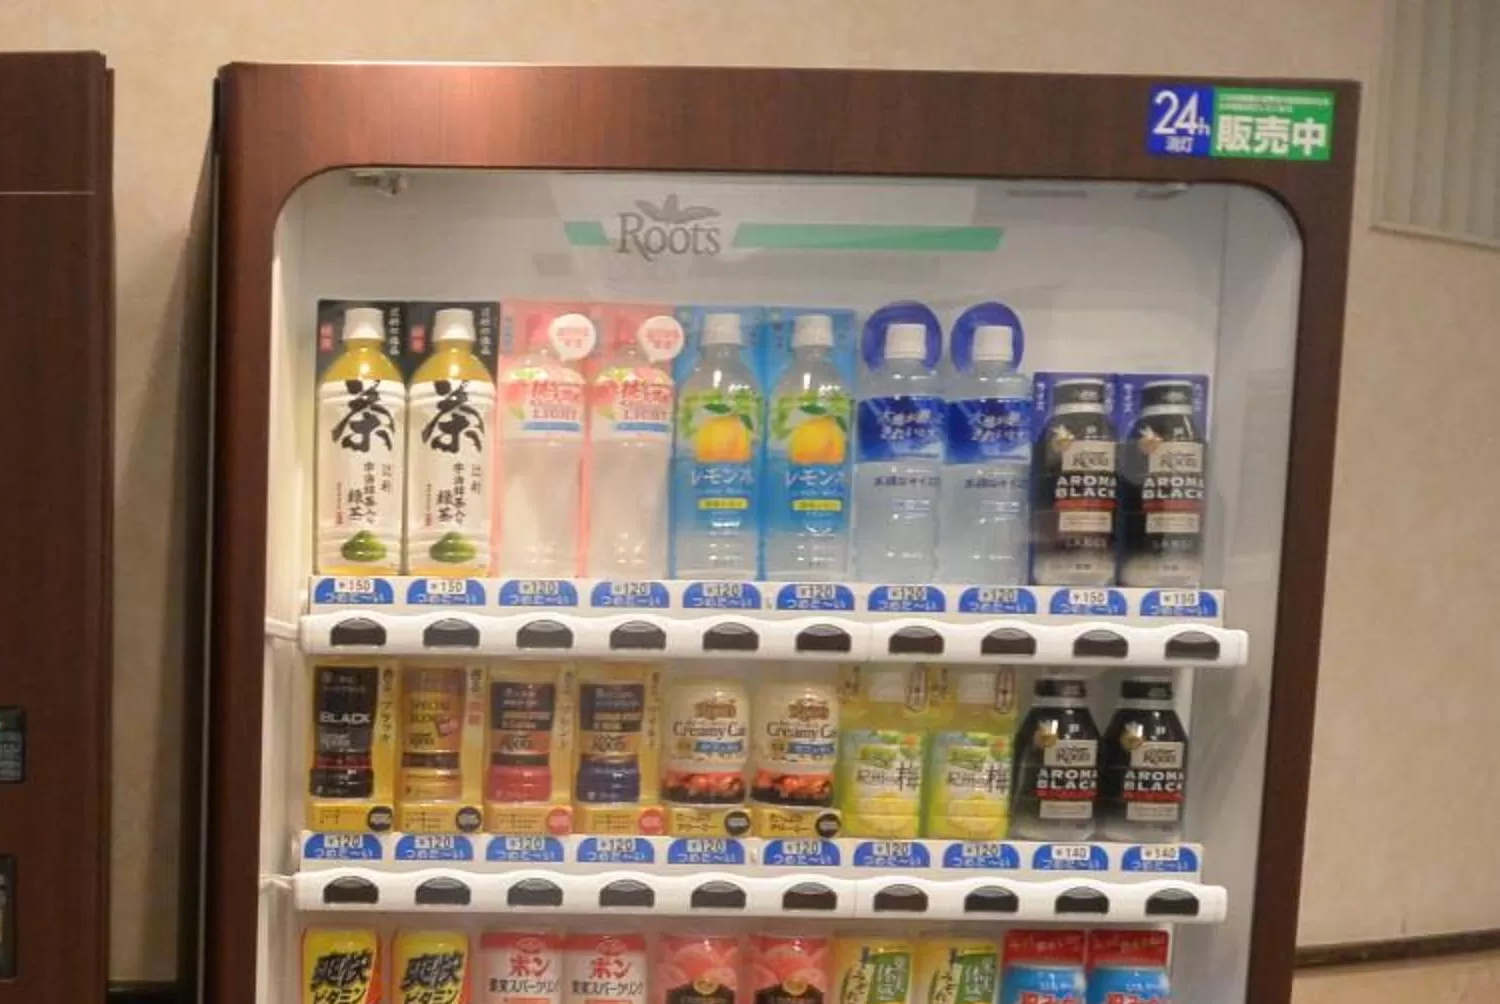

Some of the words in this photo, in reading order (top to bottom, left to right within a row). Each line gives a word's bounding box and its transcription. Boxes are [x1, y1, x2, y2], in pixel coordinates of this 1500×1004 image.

[1216, 114, 1328, 157] 販売中
[617, 211, 722, 262] Roots
[331, 379, 395, 453] 茶
[421, 379, 485, 454] 茶
[319, 712, 371, 725] BLACK
[672, 722, 726, 741] Creamy
